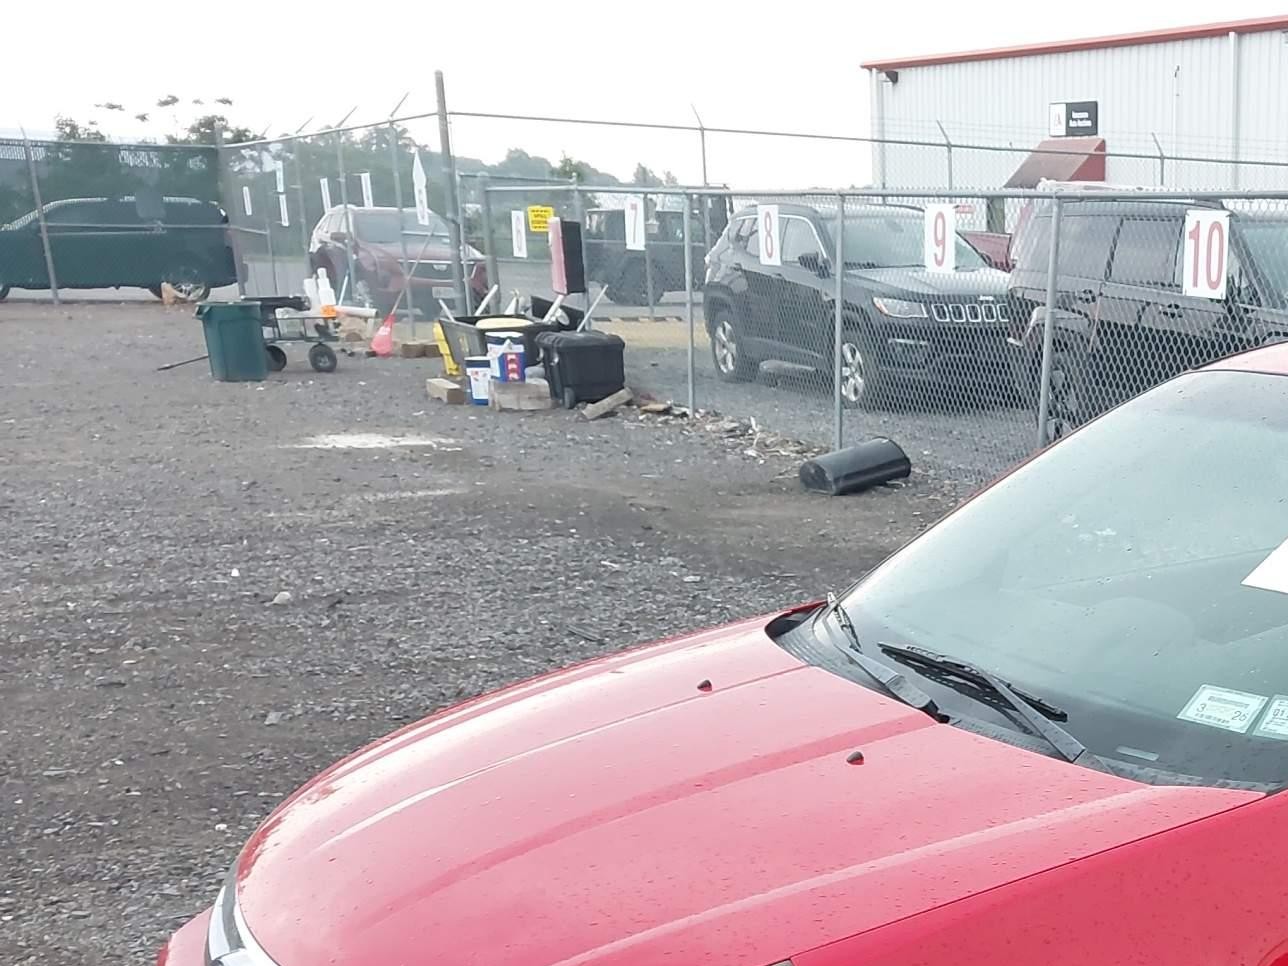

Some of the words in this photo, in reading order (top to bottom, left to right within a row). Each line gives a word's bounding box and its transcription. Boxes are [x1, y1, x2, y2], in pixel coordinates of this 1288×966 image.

[764, 211, 774, 259] 8
[933, 211, 947, 268] 9
[1187, 218, 1225, 291] 10
